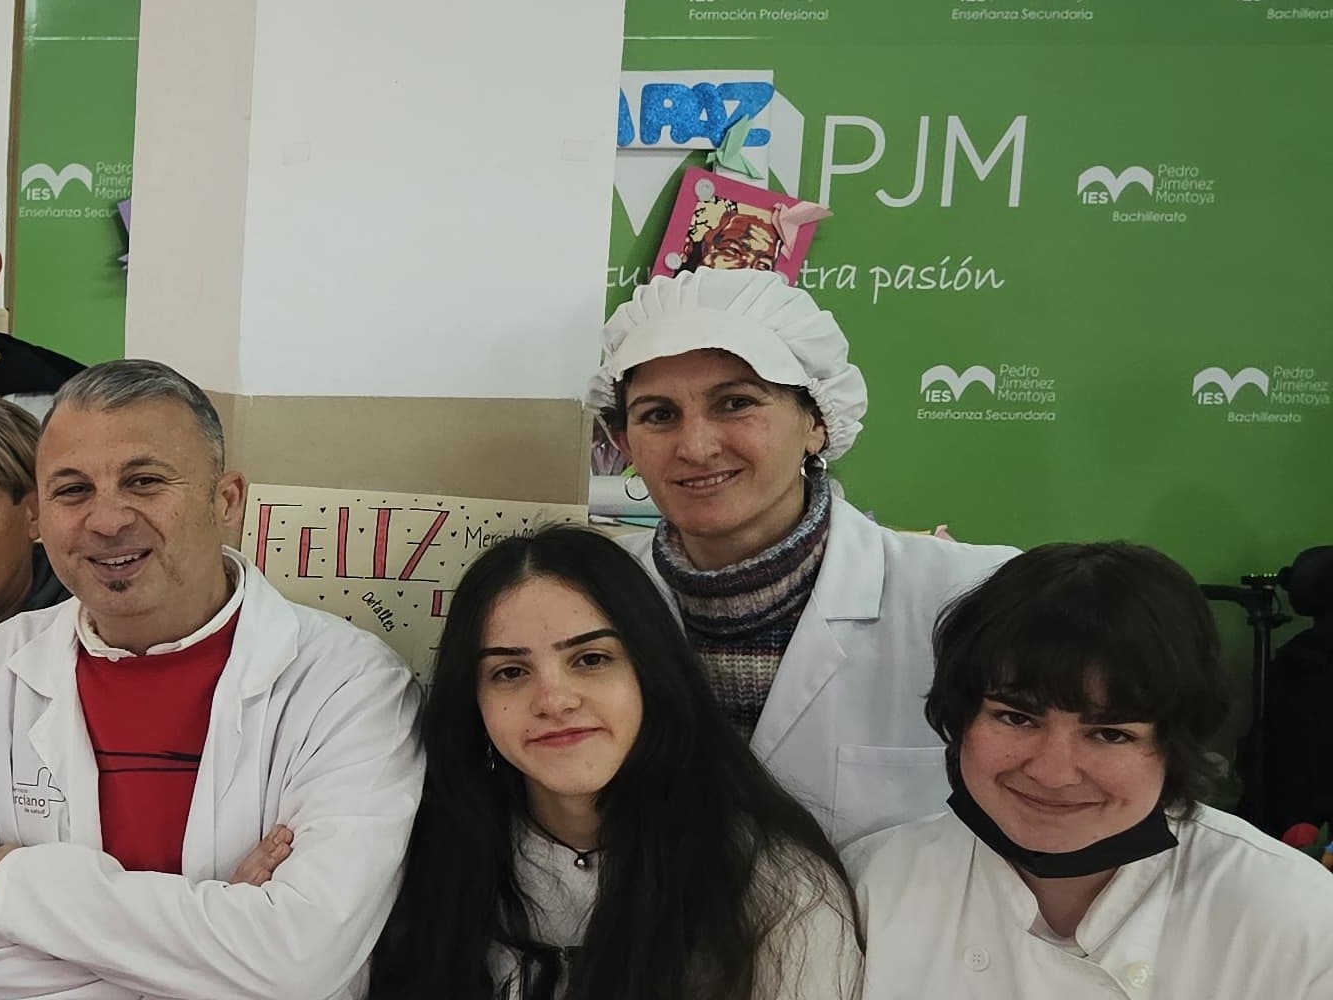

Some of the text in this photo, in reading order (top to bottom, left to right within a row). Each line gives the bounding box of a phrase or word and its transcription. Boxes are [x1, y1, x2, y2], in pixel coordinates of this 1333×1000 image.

[688, 6, 830, 22] Formación Profesional
[950, 6, 1094, 22] Enseñanza Secundaria
[1266, 7, 1333, 20] Bachillerat
[640, 81, 775, 147] PAZ
[819, 114, 1028, 208] PJM
[1158, 163, 1199, 178] Pedro
[1156, 177, 1214, 191] Jiménez
[26, 187, 51, 201] IES
[1082, 191, 1109, 205] IES
[1155, 190, 1215, 206] Montoya
[18, 206, 82, 218] Enseñanza
[1112, 210, 1187, 223] Bachillerato
[872, 256, 1005, 303] pasión
[999, 363, 1040, 378] Pedro
[1272, 366, 1315, 379] Pedro
[997, 376, 1054, 390] Jiménez
[1271, 378, 1329, 392] Jiménez
[925, 390, 951, 403] IES
[996, 389, 1057, 403] Montoya
[1197, 392, 1224, 405] IES
[1269, 391, 1331, 405] Montoya
[916, 408, 1056, 421] Enseñanza Secundaria
[1227, 410, 1302, 423] Bachillerato
[255, 503, 450, 583] FELIZ
[361, 590, 396, 632] Detalles
